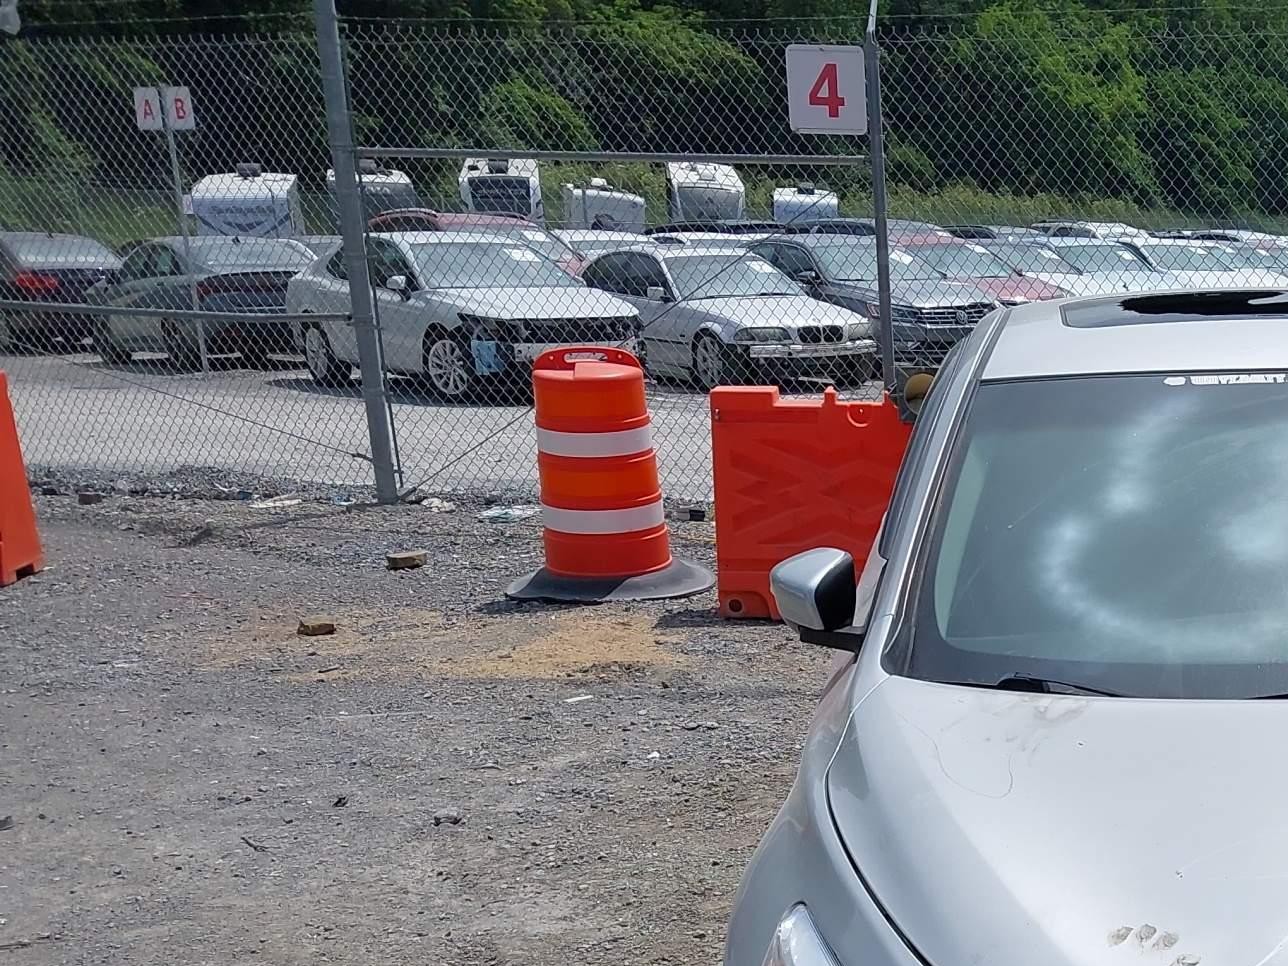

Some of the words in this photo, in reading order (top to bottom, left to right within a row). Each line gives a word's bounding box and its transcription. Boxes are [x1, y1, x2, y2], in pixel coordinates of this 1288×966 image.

[808, 63, 845, 118] 4
[143, 99, 155, 120] A
[174, 98, 186, 119] B
